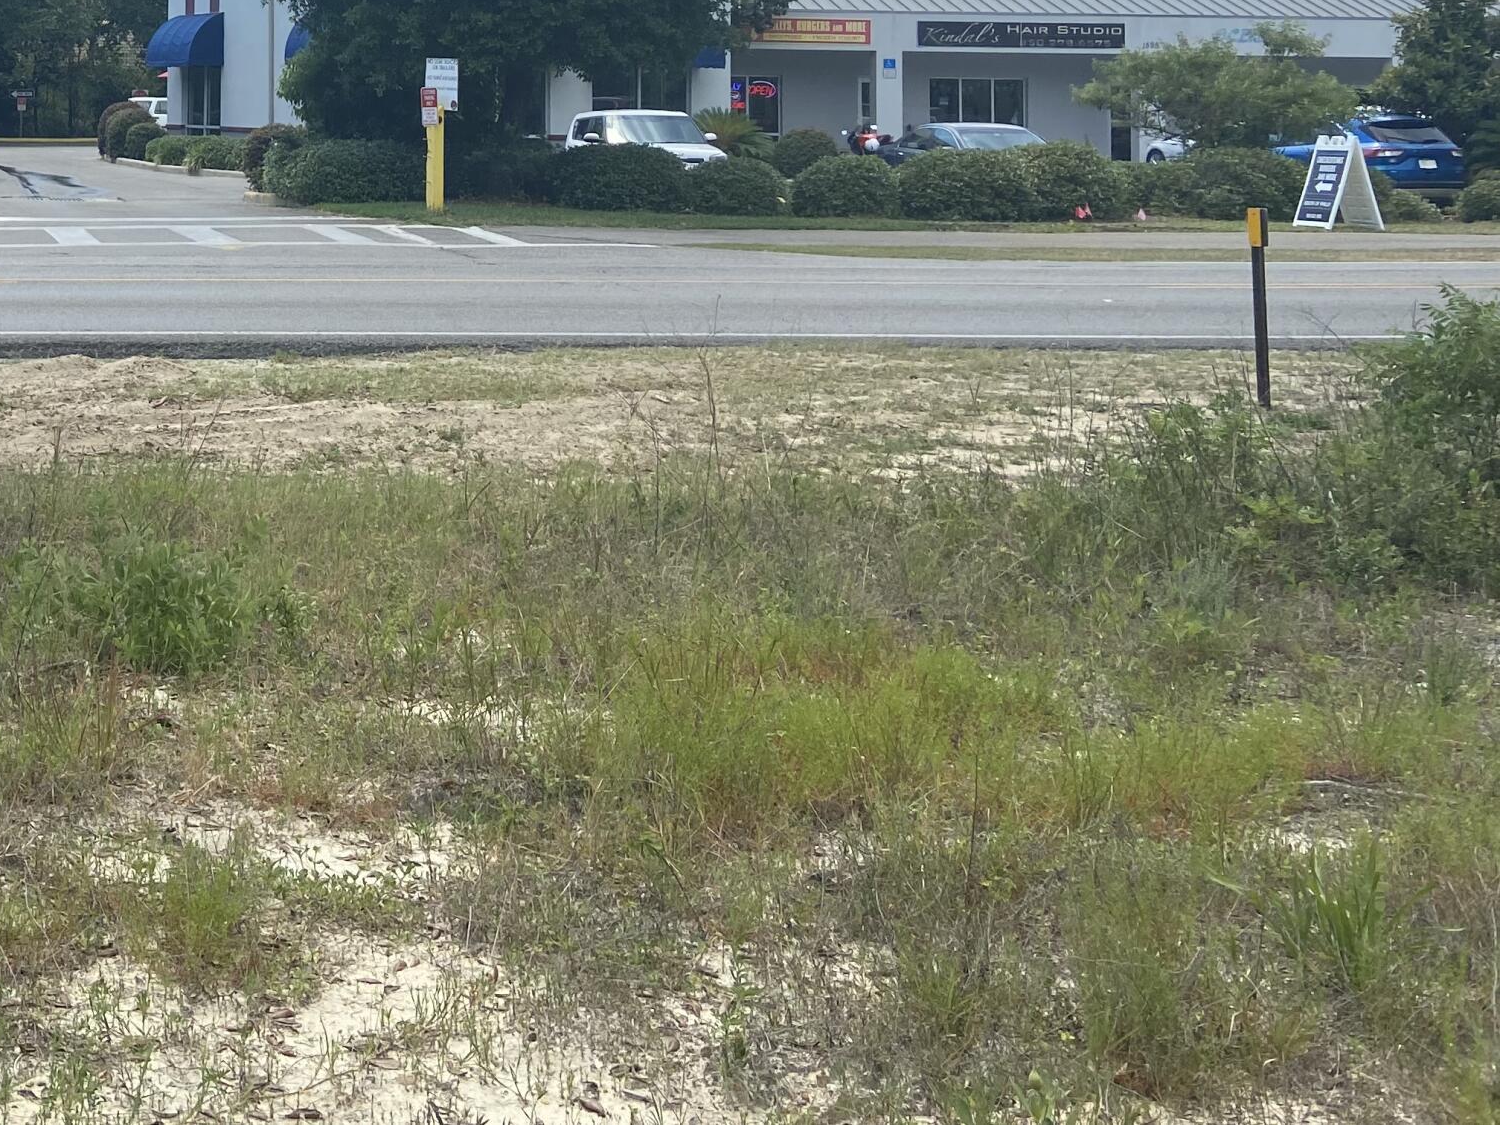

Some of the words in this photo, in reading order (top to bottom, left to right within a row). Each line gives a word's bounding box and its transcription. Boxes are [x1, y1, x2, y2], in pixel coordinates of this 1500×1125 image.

[796, 20, 830, 32] BURGERS
[845, 21, 866, 32] MORE
[923, 22, 1001, 45] Kindal's
[749, 85, 773, 96] OPEN
